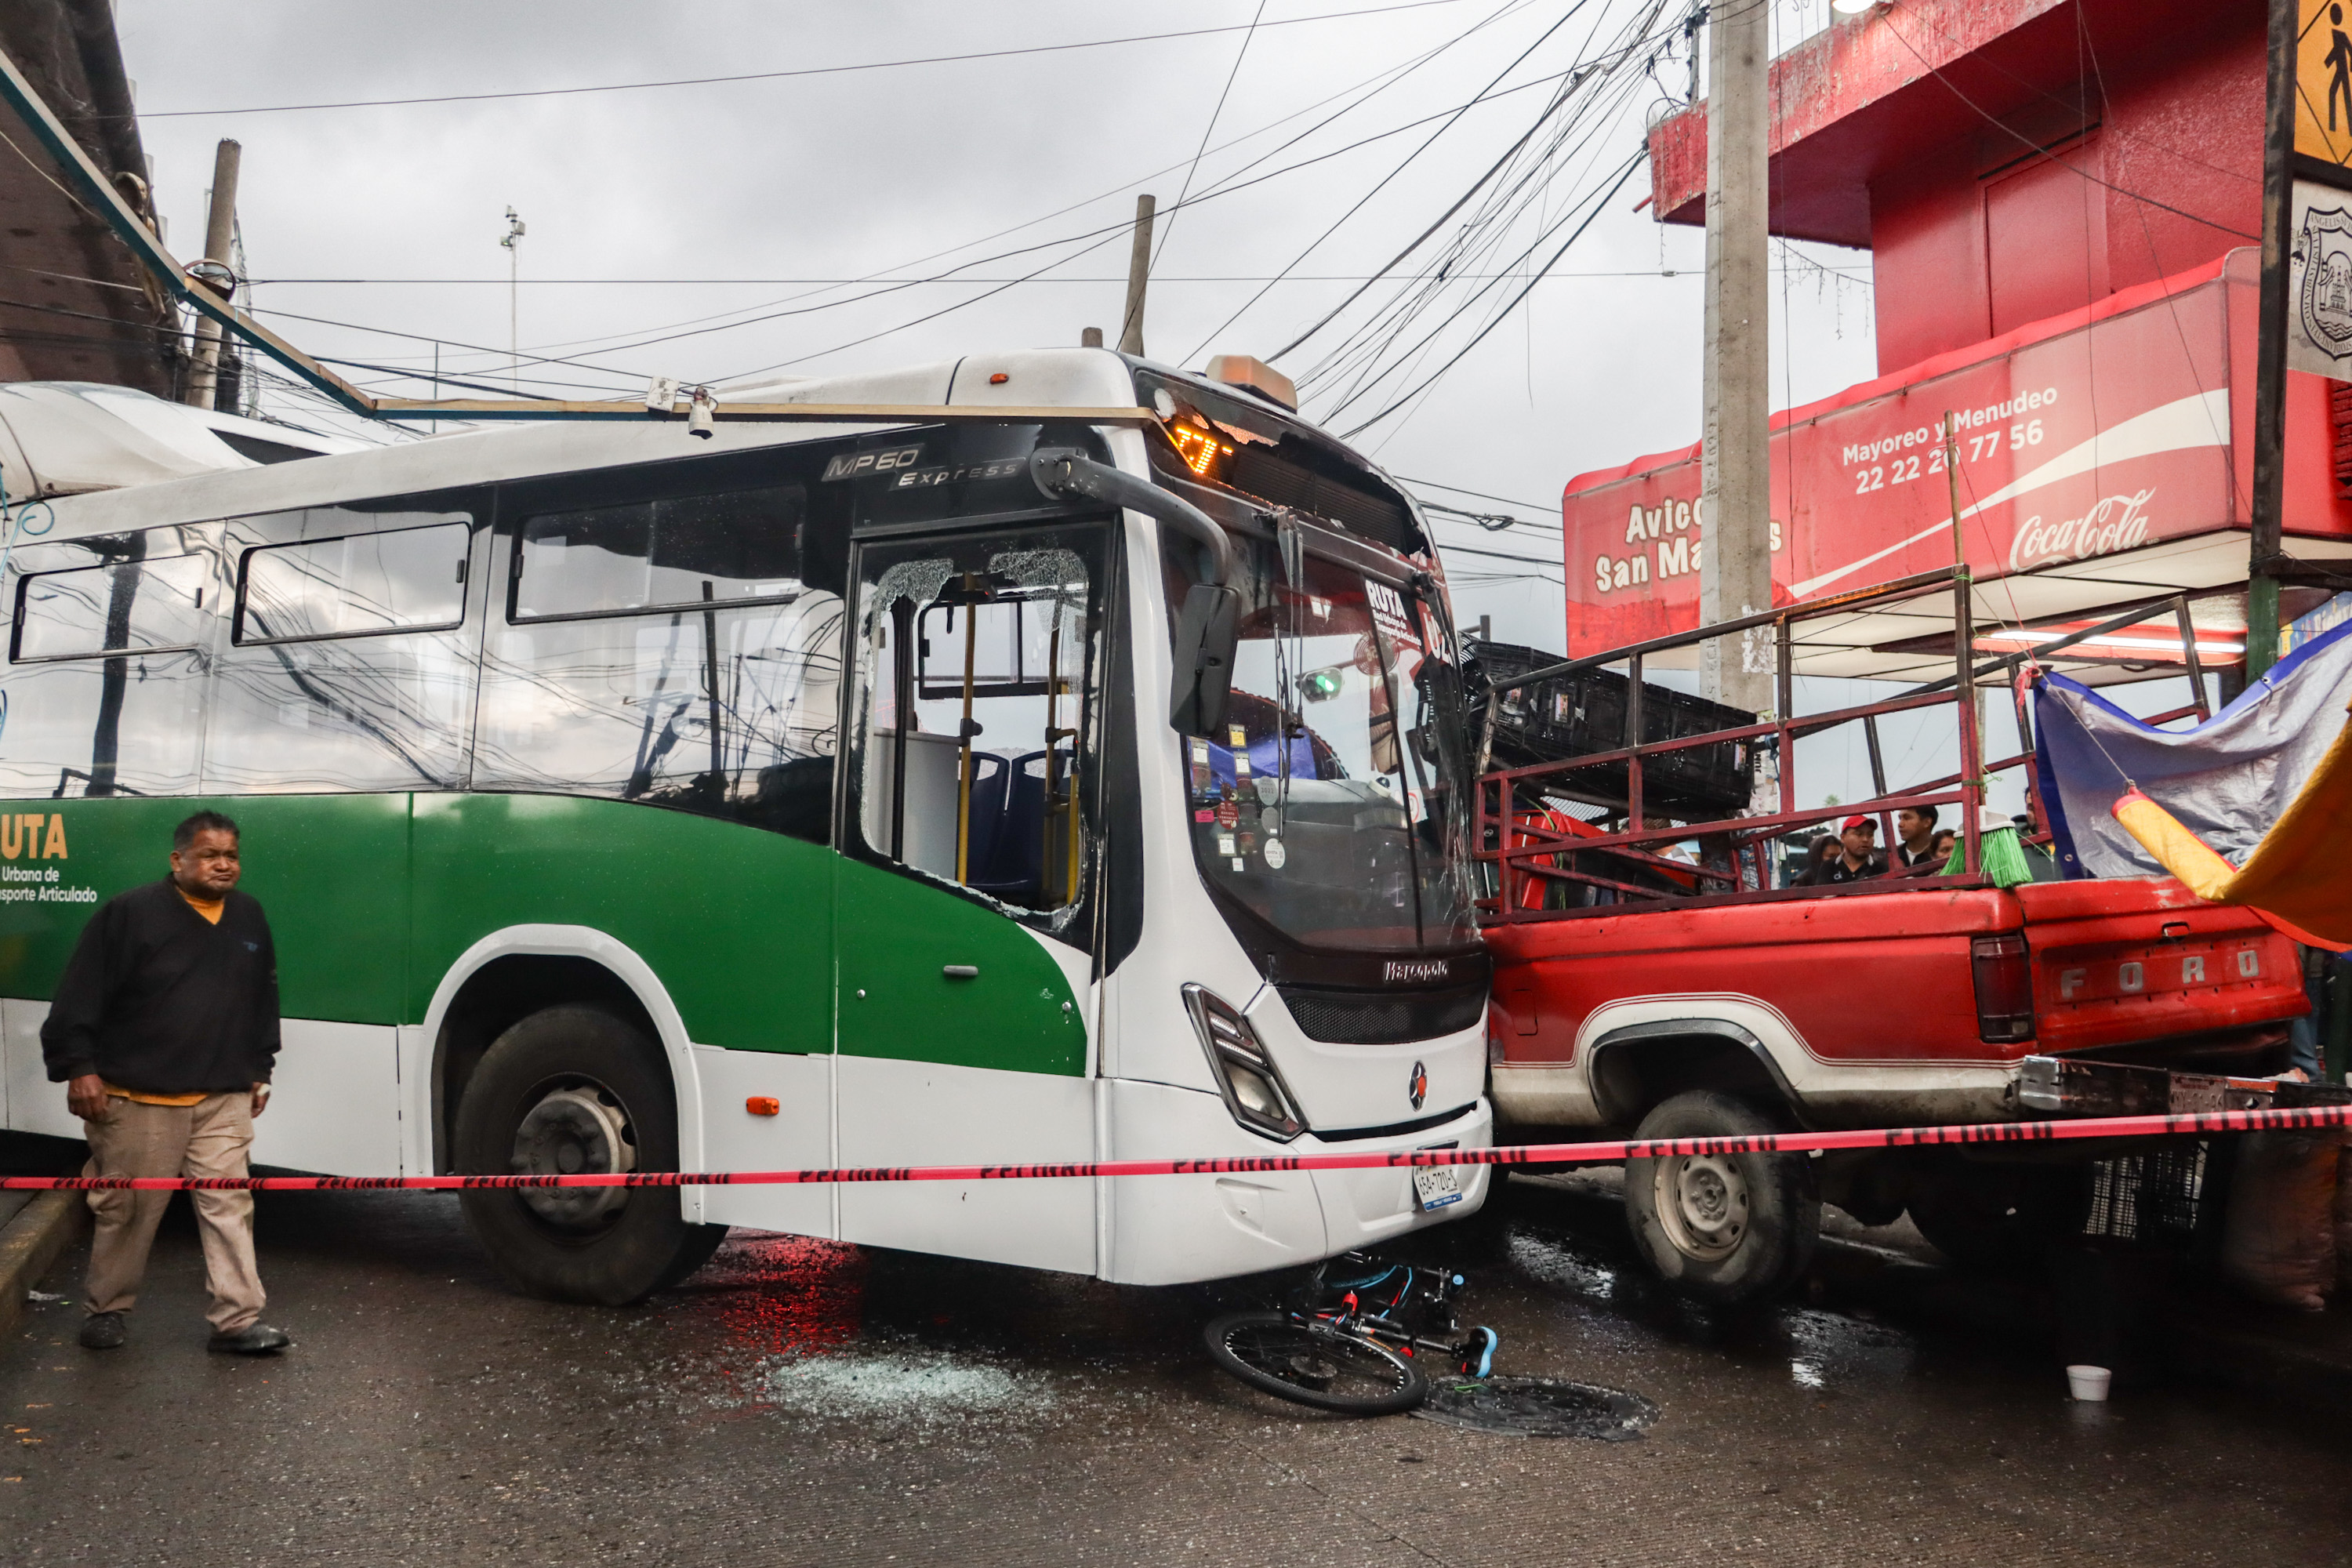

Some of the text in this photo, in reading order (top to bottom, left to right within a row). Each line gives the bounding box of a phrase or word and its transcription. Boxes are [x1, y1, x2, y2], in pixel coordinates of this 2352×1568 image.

[1844, 387, 2057, 466] Mayoreo y Menudeo
[829, 449, 919, 476] MP60
[1857, 466, 1884, 494] 22
[1892, 456, 1920, 484] 22
[1969, 431, 2000, 463] 77
[2010, 419, 2043, 450] 56
[2009, 486, 2156, 572] Coca-Cola
[1596, 555, 1648, 592] San
[1366, 579, 1407, 620] RUTA
[2, 866, 60, 882] Urbana de
[38, 886, 97, 902] Articulado
[2060, 949, 2259, 999] FORD
